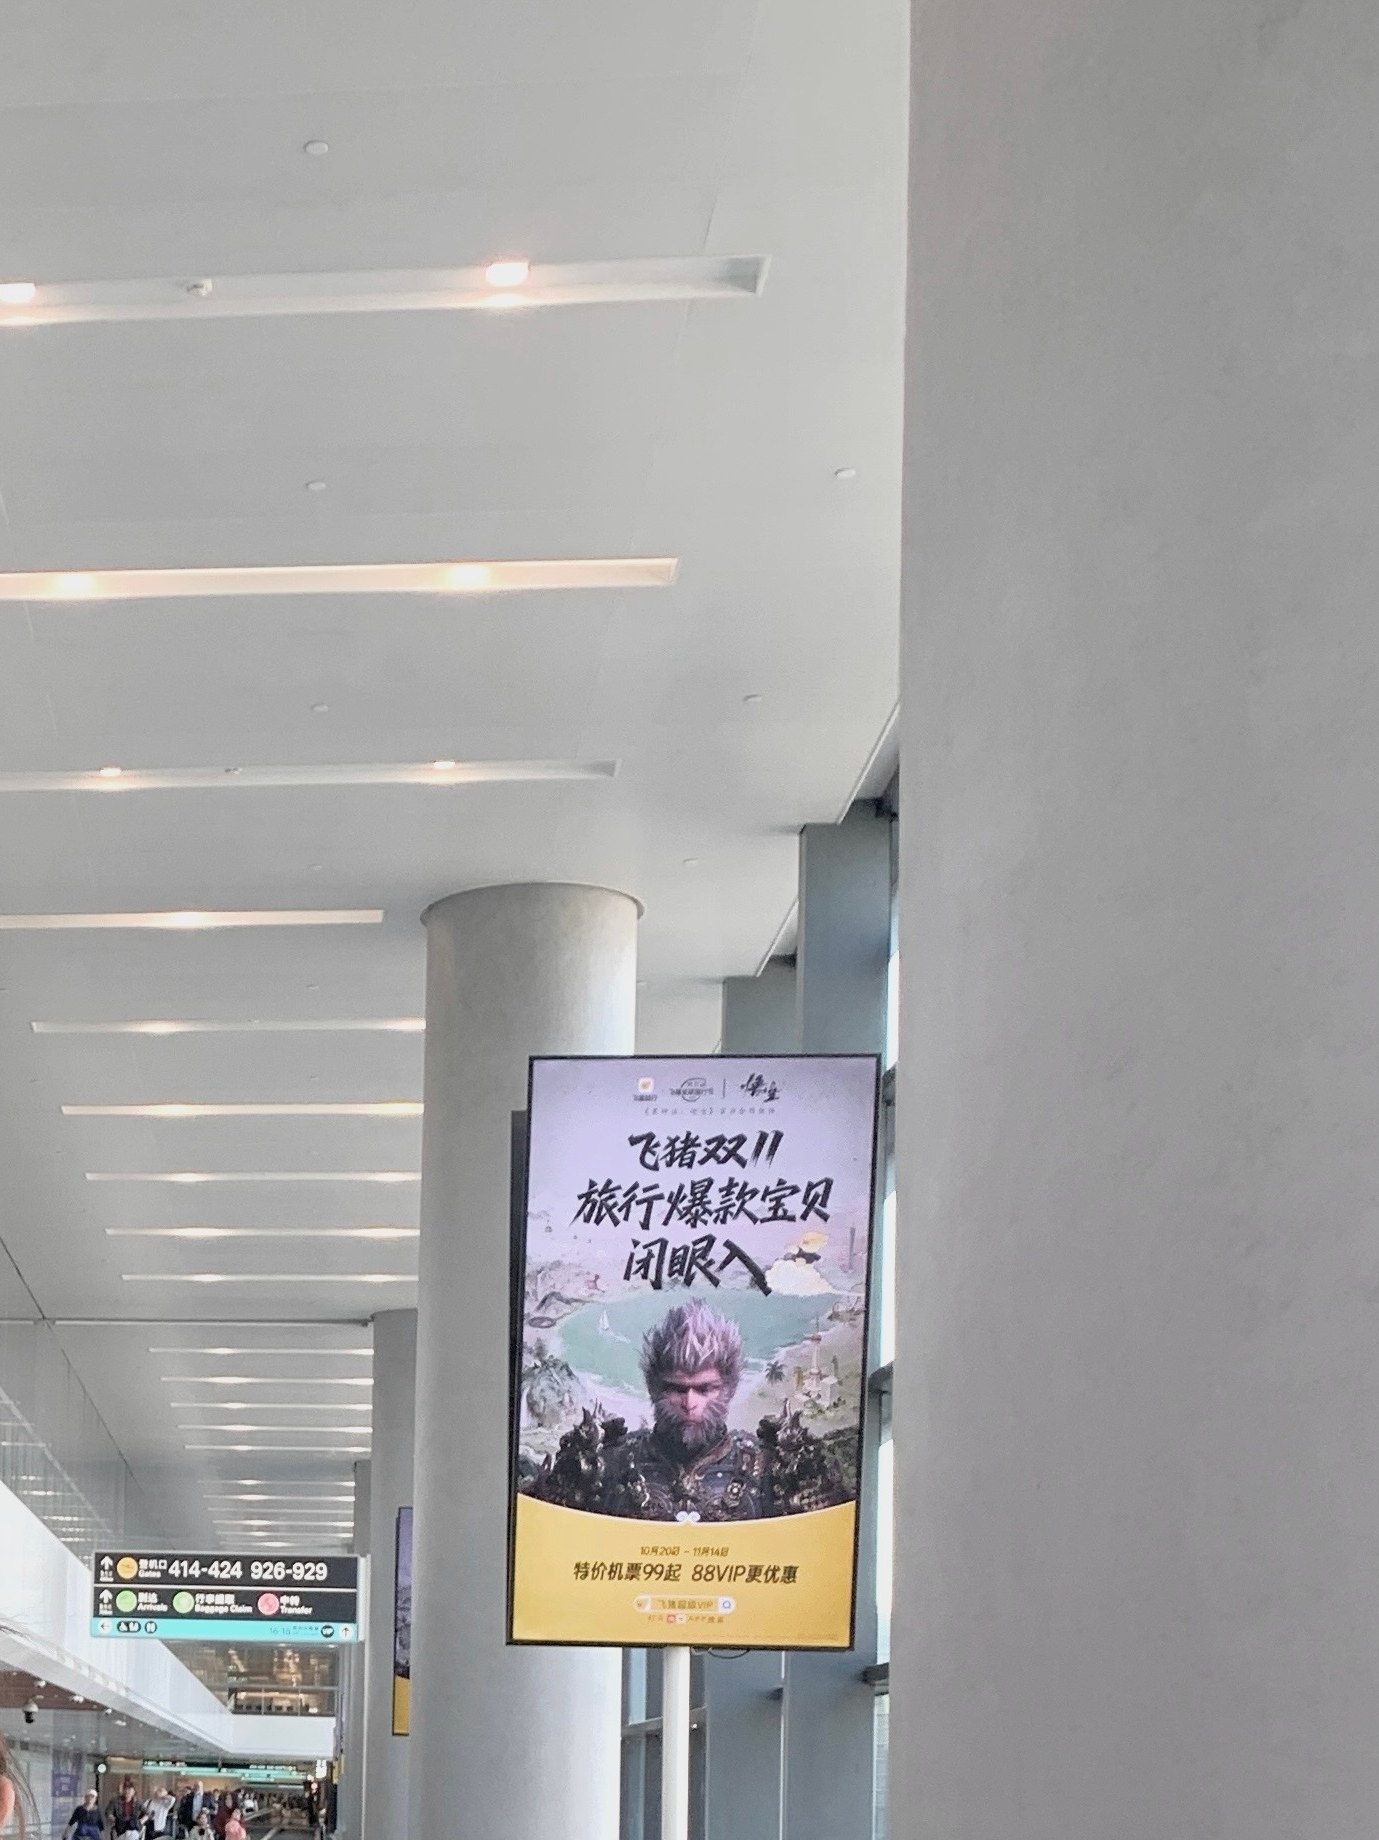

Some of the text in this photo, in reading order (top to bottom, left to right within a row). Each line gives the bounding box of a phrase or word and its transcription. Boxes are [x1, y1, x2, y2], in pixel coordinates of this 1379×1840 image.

[628, 1130, 784, 1172] 飞猪双11
[570, 1176, 834, 1231] 旅行爆款宝贝
[623, 1233, 772, 1297] 闭眼入
[640, 1546, 680, 1556] 10月20日
[138, 1569, 161, 1578] Gates
[168, 1559, 242, 1579] 414-424
[250, 1560, 328, 1581] 926-929
[573, 1561, 800, 1584] 特价机票99起 88VIP更优惠
[137, 1602, 168, 1611] Arrivals
[229, 1604, 253, 1613] Claim
[280, 1605, 313, 1614] Transfer
